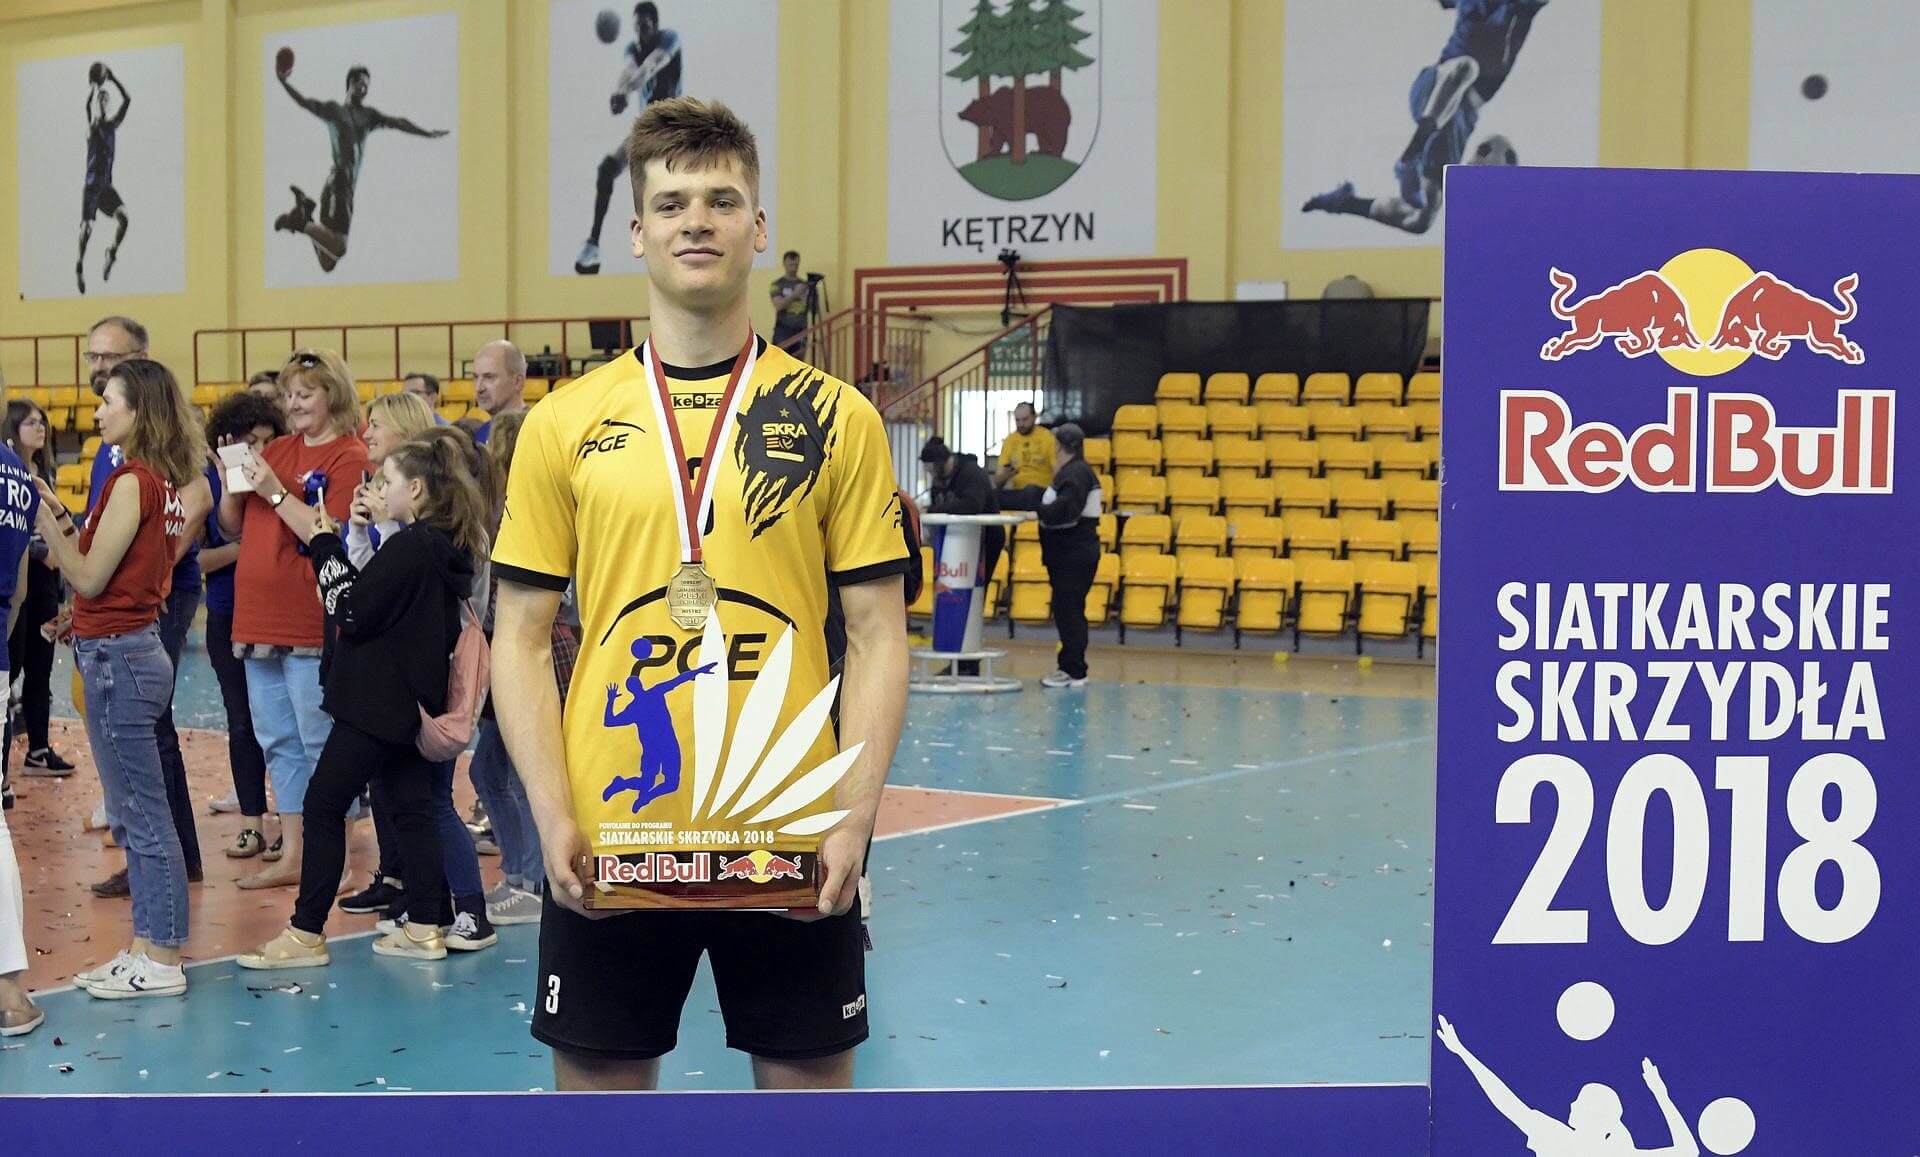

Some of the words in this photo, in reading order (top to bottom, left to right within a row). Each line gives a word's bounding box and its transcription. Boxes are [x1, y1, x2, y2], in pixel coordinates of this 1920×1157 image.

[943, 212, 1094, 253] KĘTRZYN
[577, 433, 629, 459] PGE
[762, 423, 808, 438] SKRA
[1501, 389, 1696, 492] Red
[1708, 390, 1894, 494] Bull
[1497, 582, 1891, 650] SIATKARSKIE
[1495, 660, 1886, 742] SKRZYDŁA
[600, 831, 674, 845] SIATKARSKIE
[678, 830, 740, 844] SKRZYDŁA
[743, 830, 774, 844] 2018
[1491, 752, 1882, 946] 2018
[599, 853, 655, 882] Red
[656, 853, 711, 882] Bull
[546, 974, 560, 1014] 3
